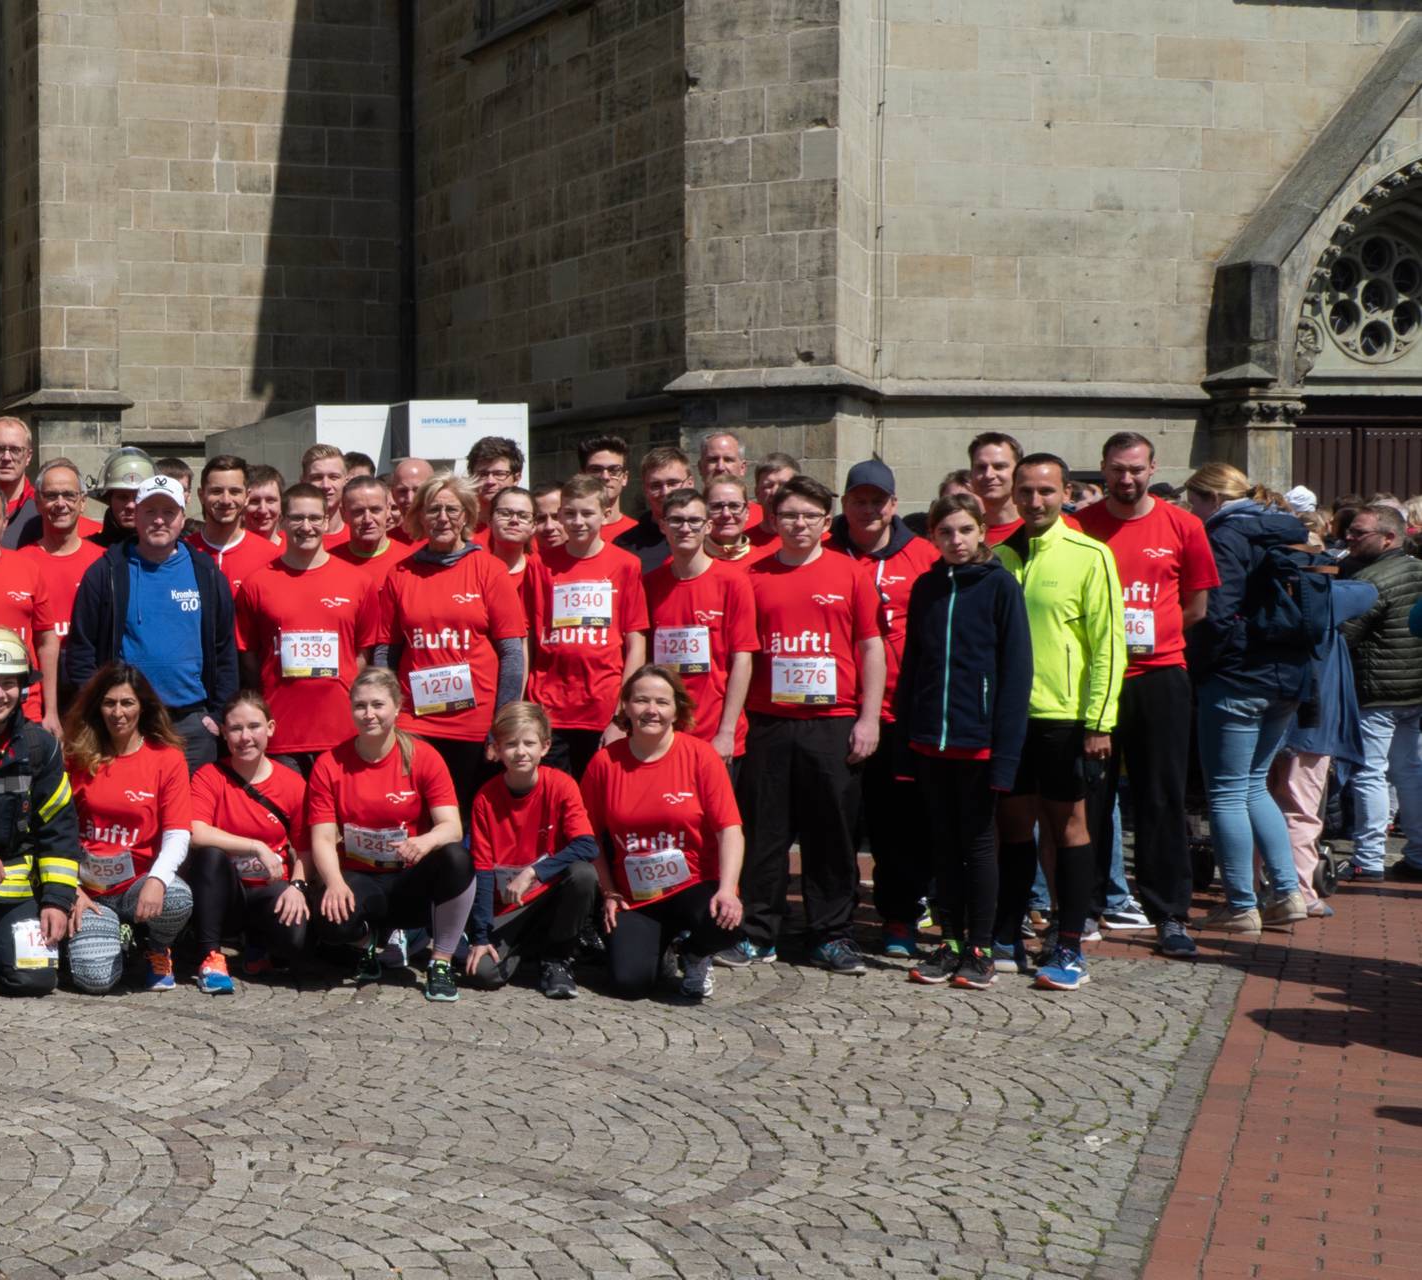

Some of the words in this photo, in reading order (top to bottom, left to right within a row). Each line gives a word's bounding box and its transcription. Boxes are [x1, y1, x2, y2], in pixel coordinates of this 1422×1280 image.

[562, 592, 603, 608] 1340
[290, 642, 332, 658] 1339
[661, 638, 700, 654] 1243
[421, 675, 463, 695] 1270
[782, 669, 827, 685] 1276
[354, 835, 396, 852] 1245
[633, 860, 679, 882] 1320
